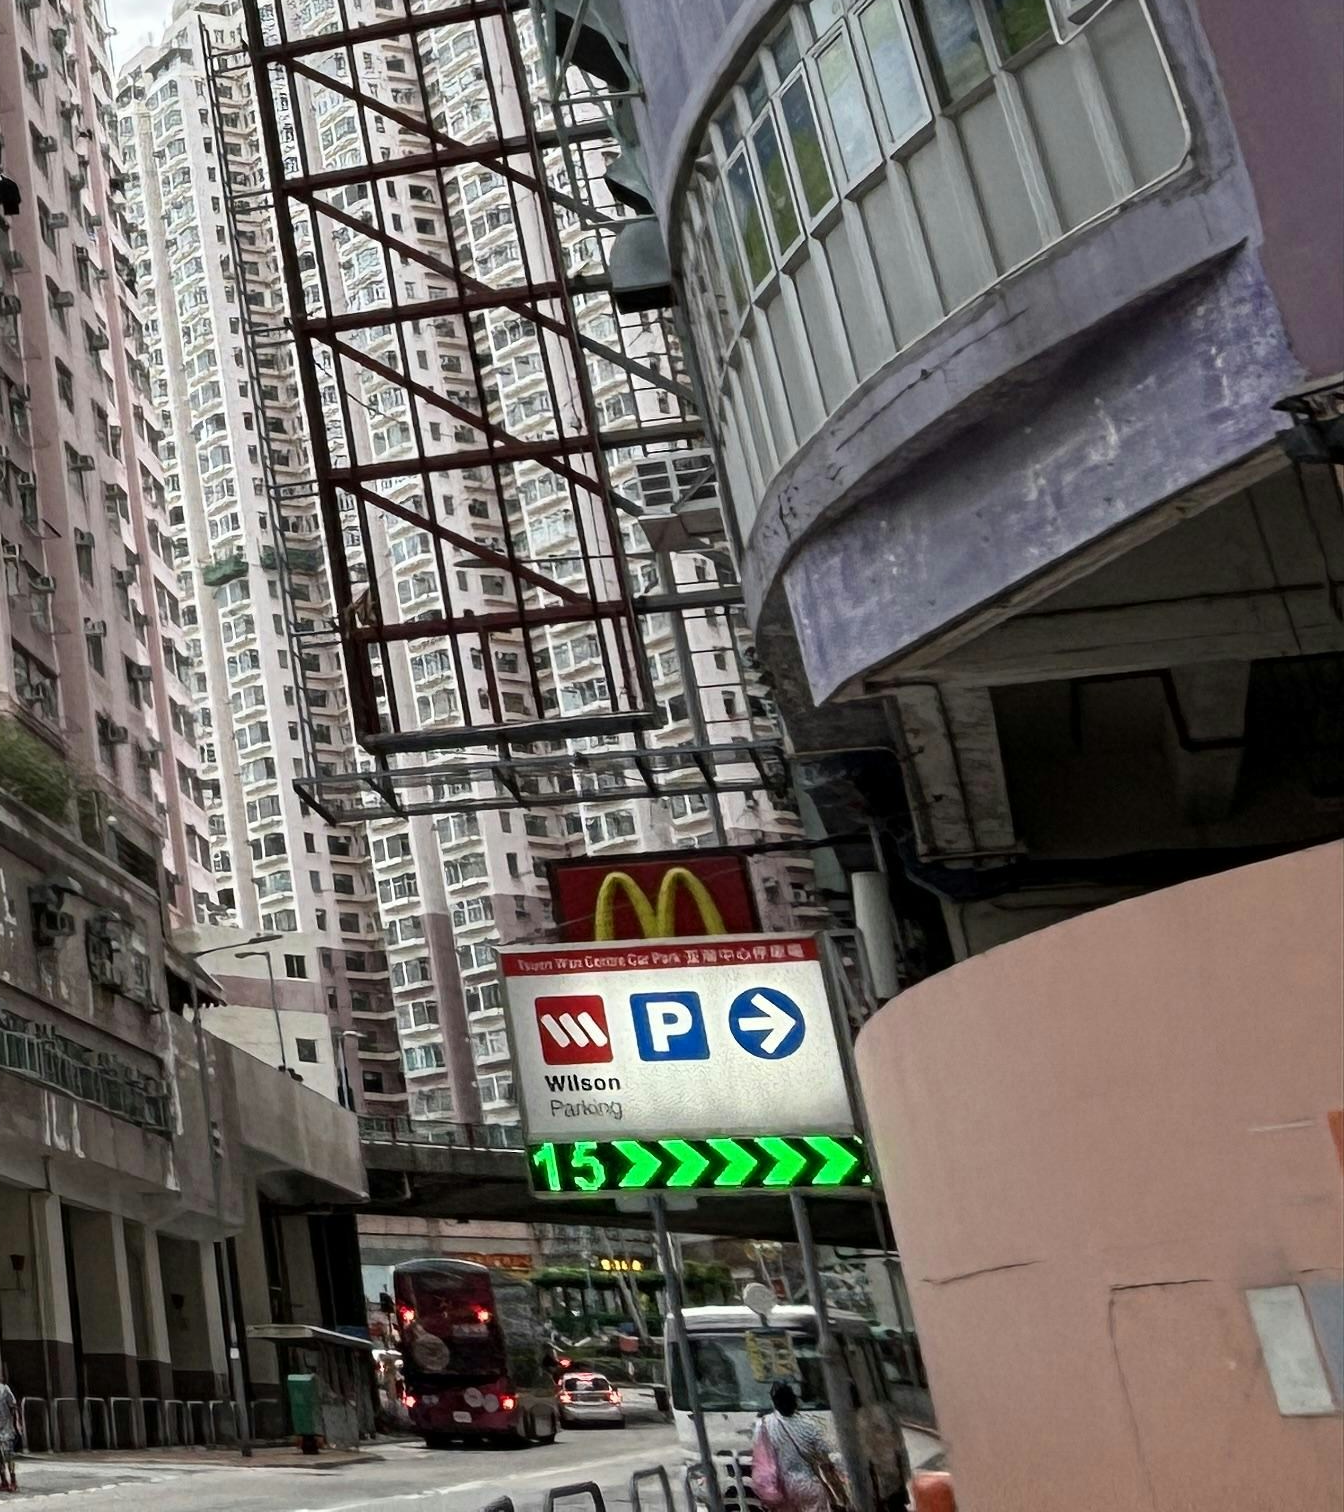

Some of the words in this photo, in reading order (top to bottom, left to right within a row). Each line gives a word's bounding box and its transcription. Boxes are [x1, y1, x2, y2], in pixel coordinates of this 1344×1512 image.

[645, 1001, 693, 1053] P
[544, 1074, 622, 1093] Wilson
[550, 1098, 623, 1121] Parking
[533, 1141, 607, 1192] 15
